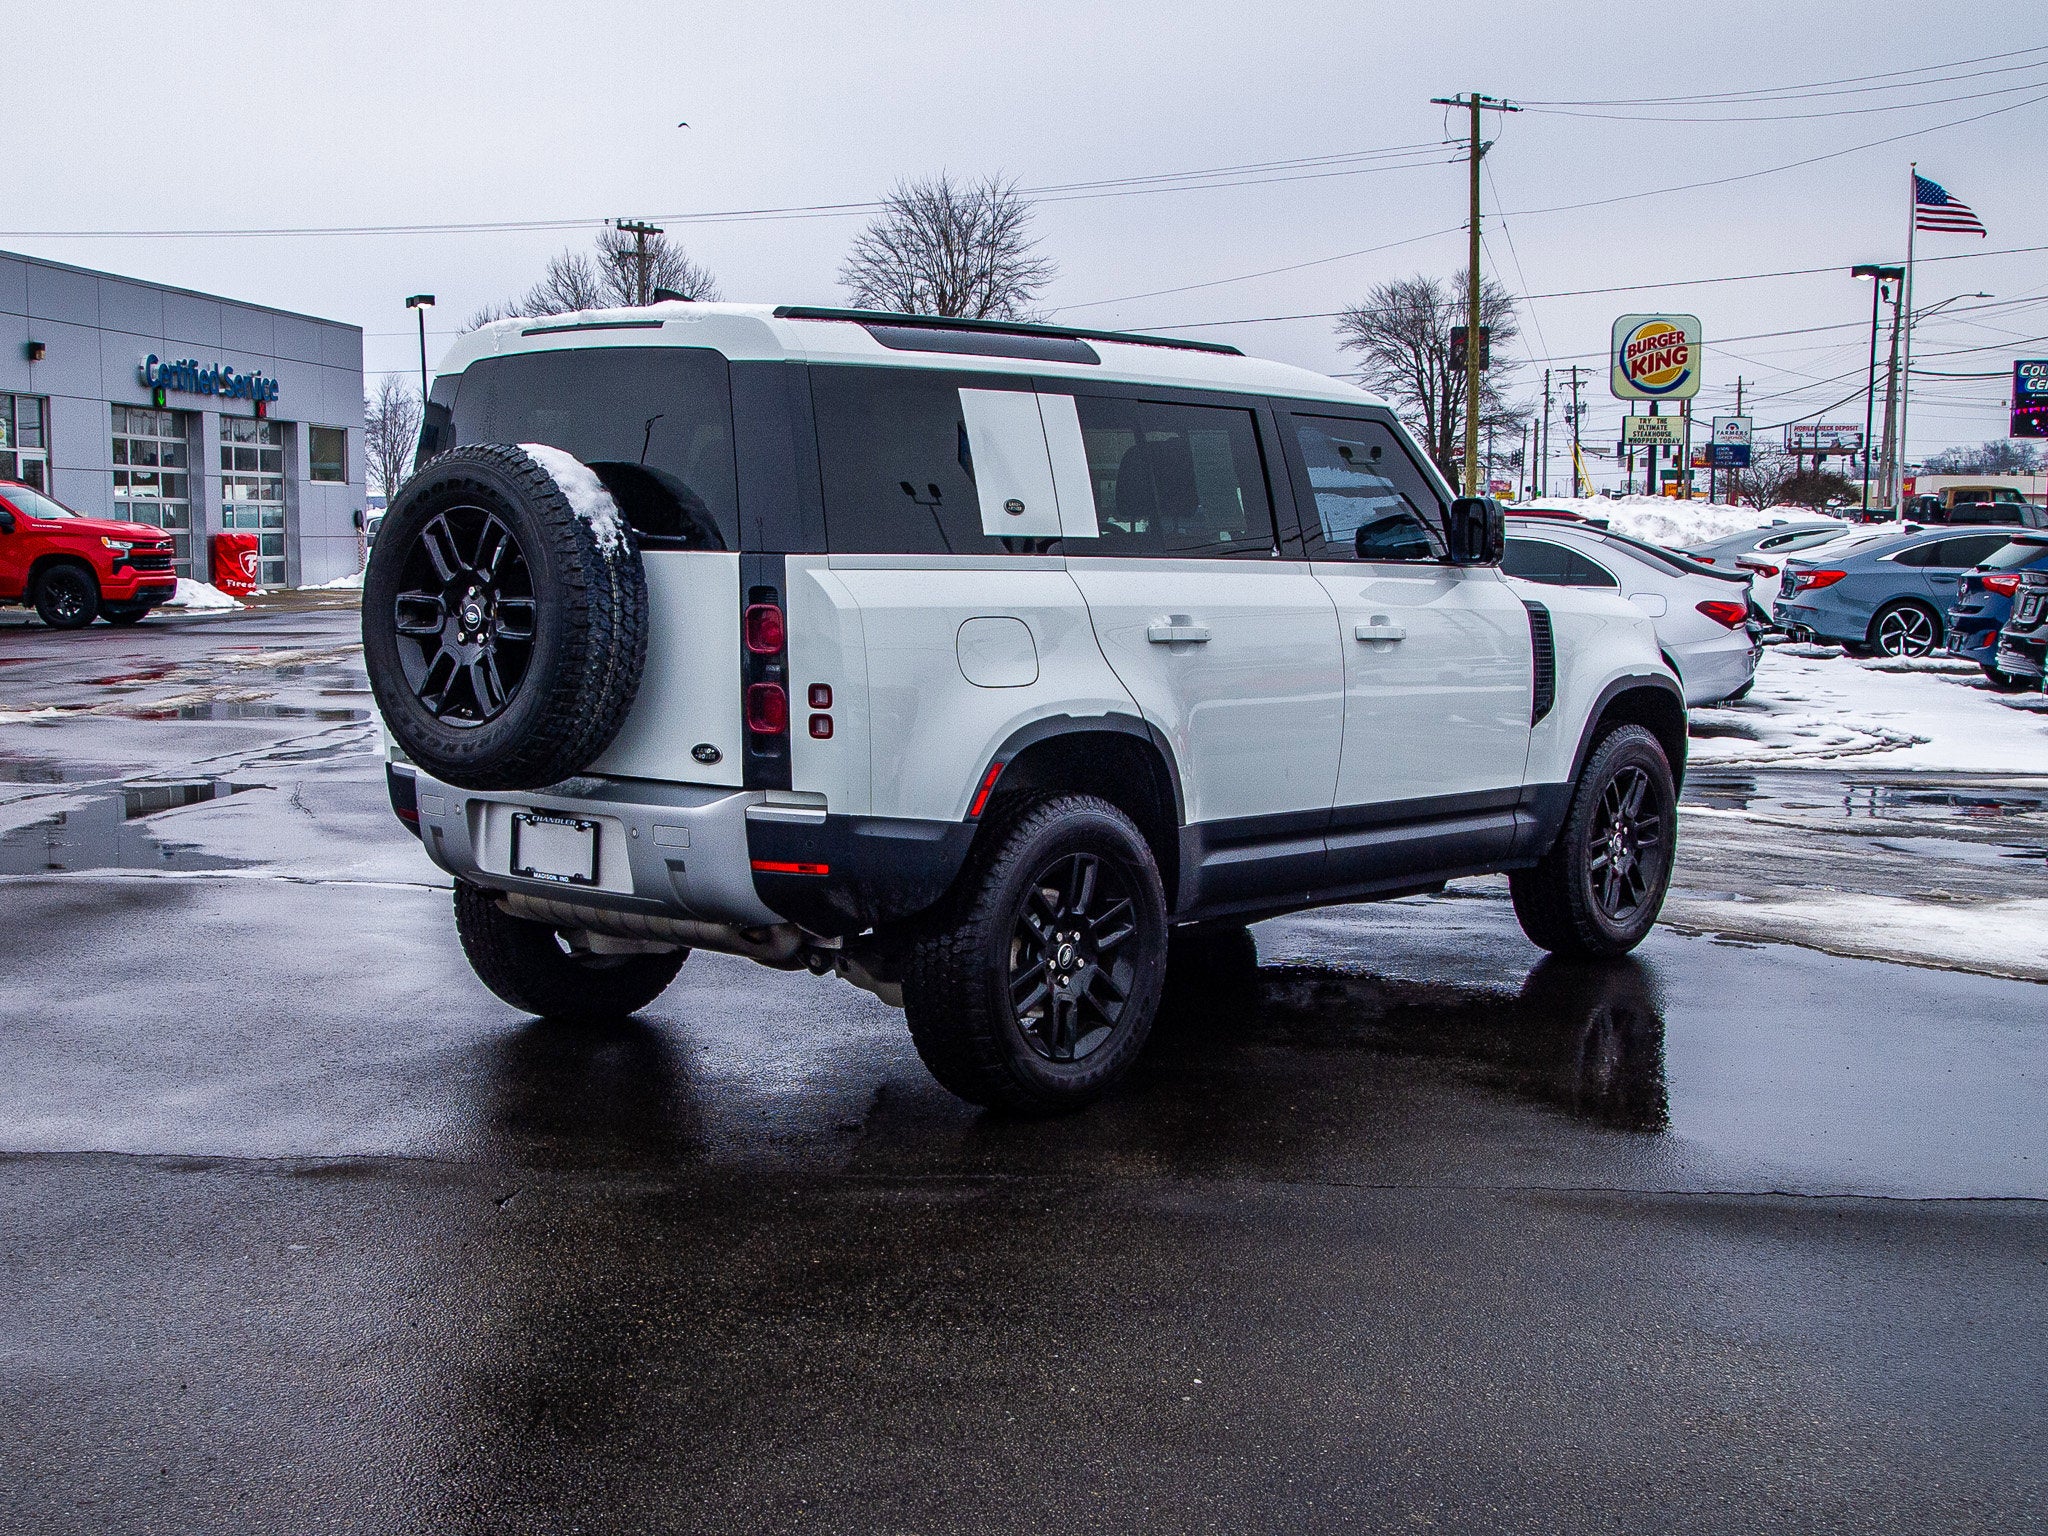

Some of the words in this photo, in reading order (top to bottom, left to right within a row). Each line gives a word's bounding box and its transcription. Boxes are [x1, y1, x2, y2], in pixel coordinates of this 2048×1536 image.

[1627, 331, 1686, 359] BURGER
[142, 353, 219, 395] Certified
[221, 365, 280, 402] Service
[1630, 346, 1689, 380] KING
[531, 815, 577, 826] CHANDLER
